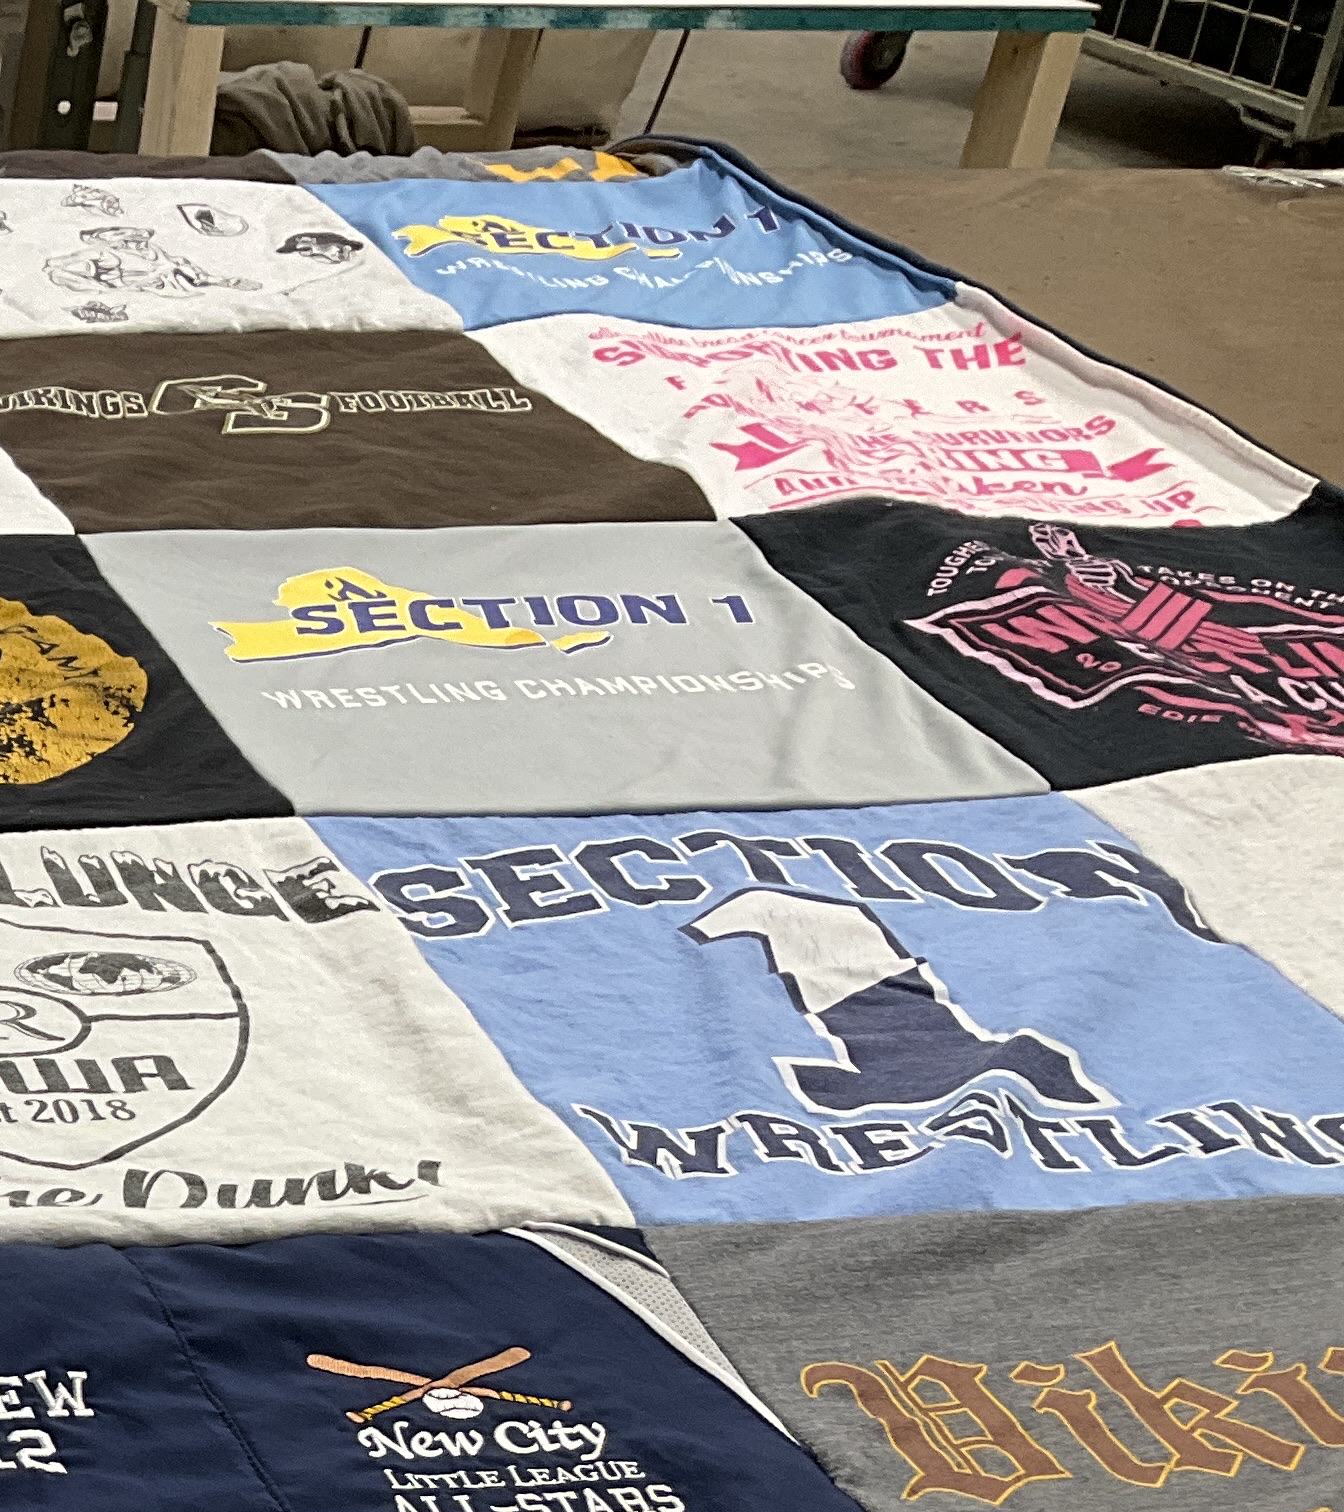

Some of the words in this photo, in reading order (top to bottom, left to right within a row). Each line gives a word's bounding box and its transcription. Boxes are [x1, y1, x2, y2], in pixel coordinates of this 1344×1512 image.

[913, 331, 1027, 371] THE
[328, 388, 533, 415] FOOTBALL
[926, 539, 991, 598] TOUGHE
[1250, 578, 1296, 593] ON
[291, 592, 691, 637] SECTION
[714, 594, 755, 625] 1
[263, 678, 510, 712] WRESTLING
[512, 660, 857, 698] CHAMPIONSHIPS
[368, 832, 1228, 943] SECTION
[679, 886, 1119, 1116] 1
[22, 1096, 138, 1125] 2018
[356, 1424, 485, 1463] New
[492, 1417, 609, 1461] City
[799, 1340, 1344, 1505] Viki
[384, 1464, 506, 1491] LITTLE
[507, 1460, 646, 1487] LEAGUE
